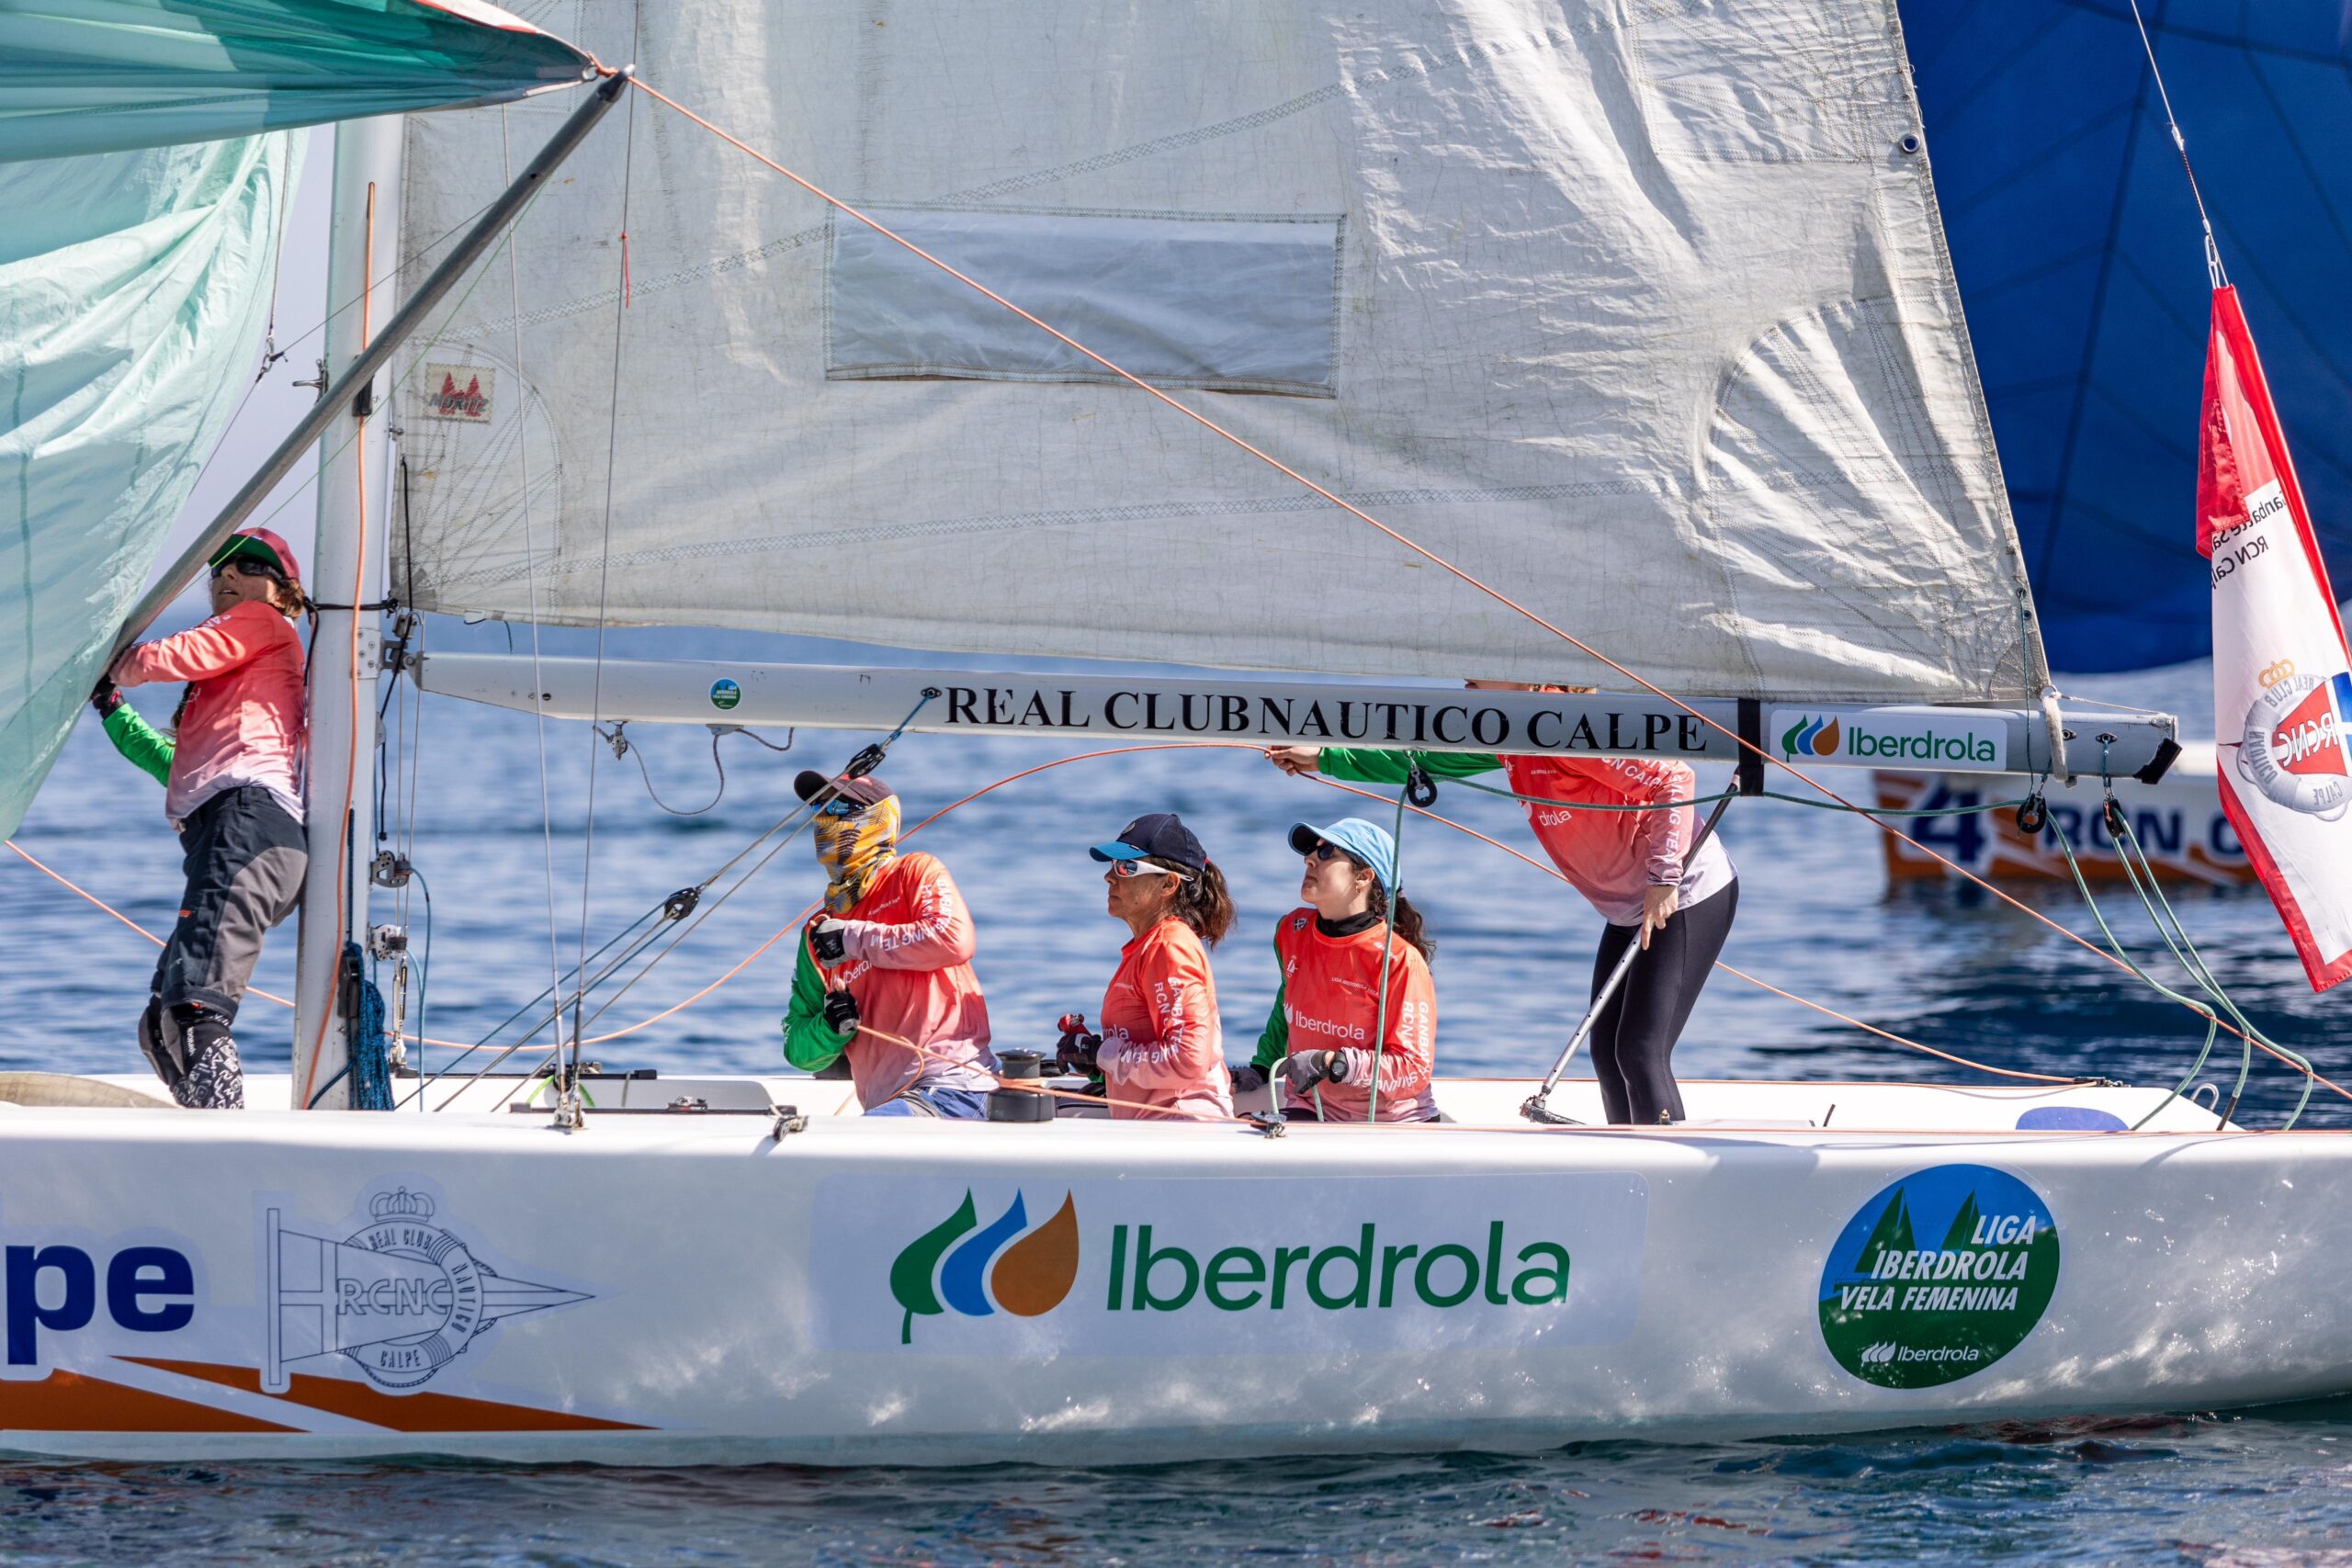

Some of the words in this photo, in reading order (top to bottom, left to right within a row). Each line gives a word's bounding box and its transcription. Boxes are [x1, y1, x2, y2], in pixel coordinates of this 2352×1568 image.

[944, 686, 1091, 728] REAL
[1526, 710, 1707, 751] CALPE
[1848, 727, 1996, 761] Iberdrola
[1154, 981, 1171, 1014] RCN
[1295, 1010, 1365, 1041] Iberdrola
[1401, 1000, 1415, 1037] RCN
[402, 1227, 433, 1250] CLUB
[1970, 1214, 2037, 1245] LIGA
[1106, 1220, 1571, 1312] Iberdrola
[1870, 1249, 2029, 1280] IBERDROLA
[336, 1278, 449, 1315] RCNC
[1840, 1286, 1895, 1311] VELA
[1900, 1286, 2018, 1311] FEMENINA
[379, 1349, 422, 1369] CALPE
[1896, 1345, 1980, 1362] Iberdrola
